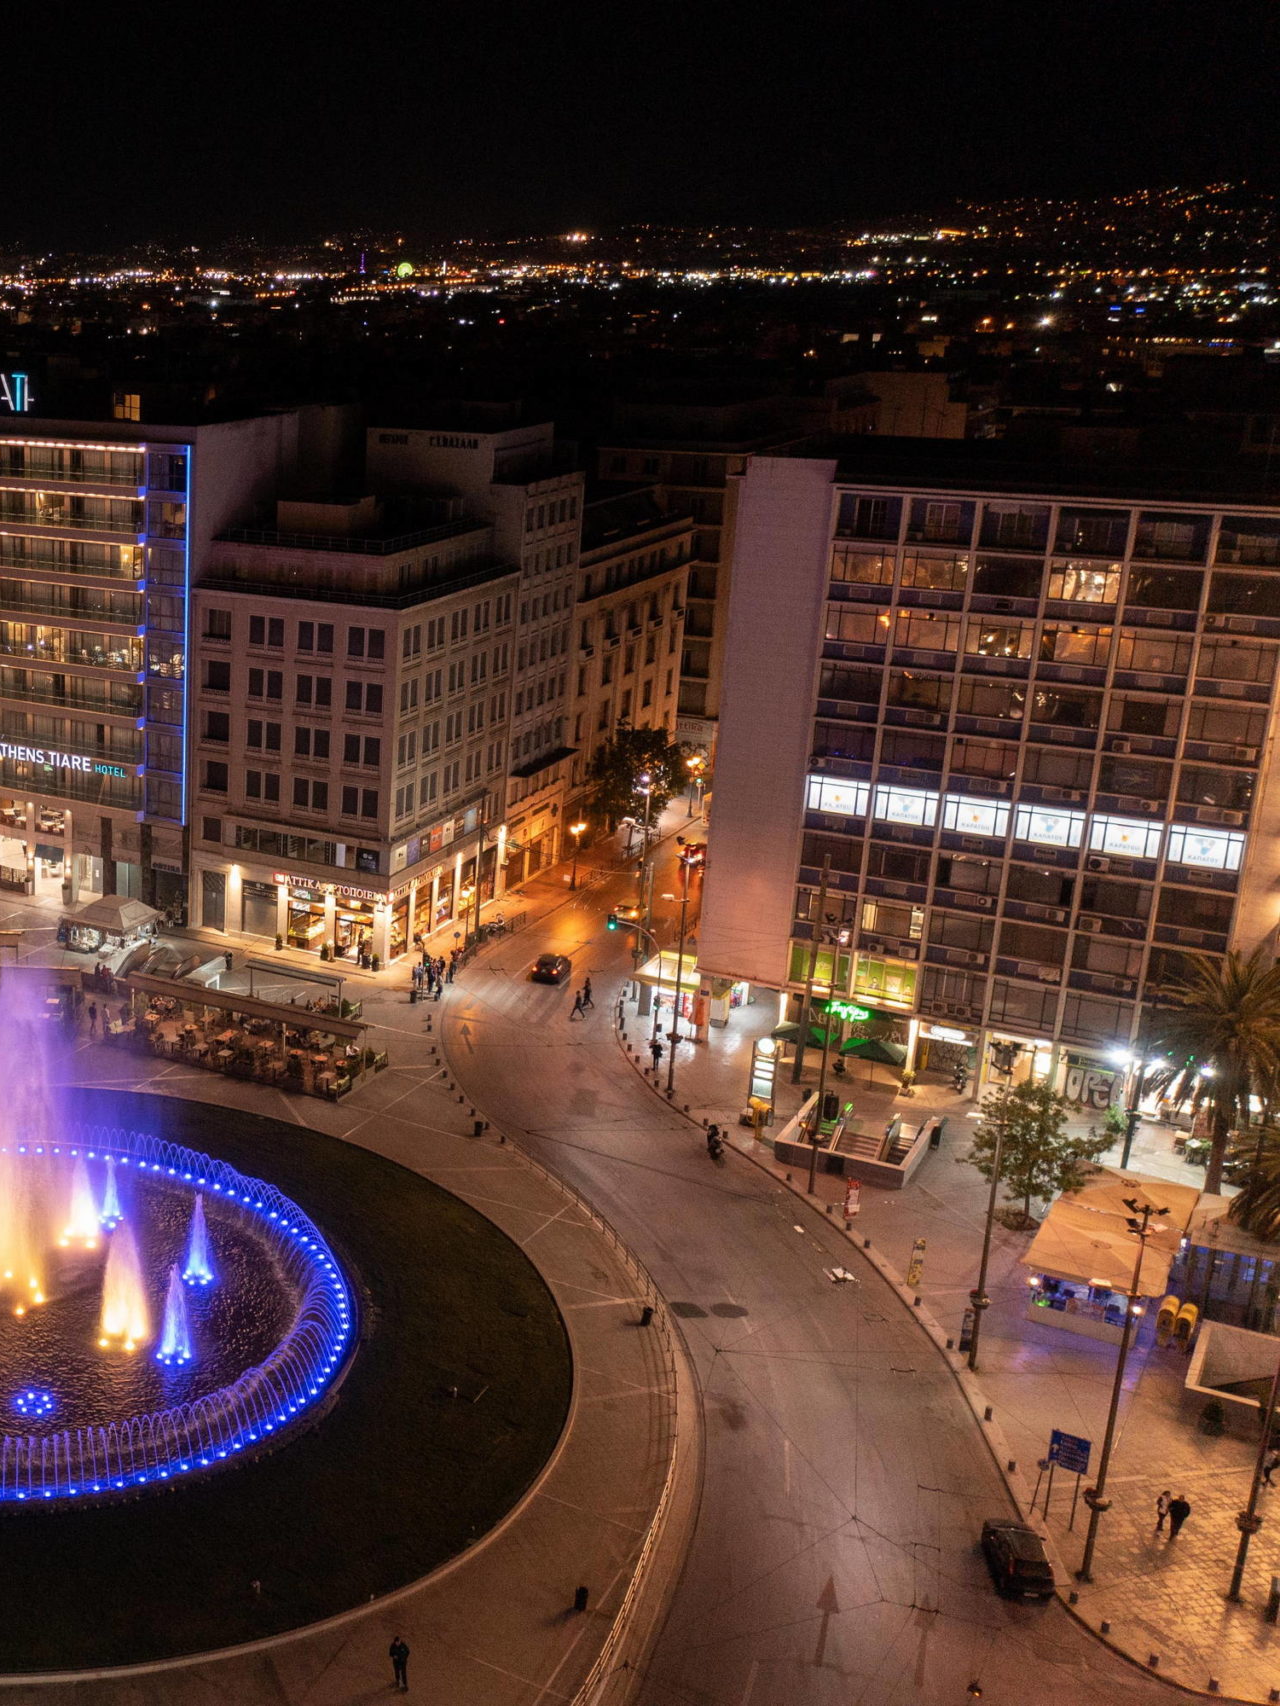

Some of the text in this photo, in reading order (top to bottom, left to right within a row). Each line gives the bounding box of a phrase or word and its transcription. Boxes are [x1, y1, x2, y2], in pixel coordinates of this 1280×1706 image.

[48, 751, 92, 772] TIARE
[95, 764, 127, 778] HOTEL
[285, 874, 321, 890] ΑΤΤΙΚΑ
